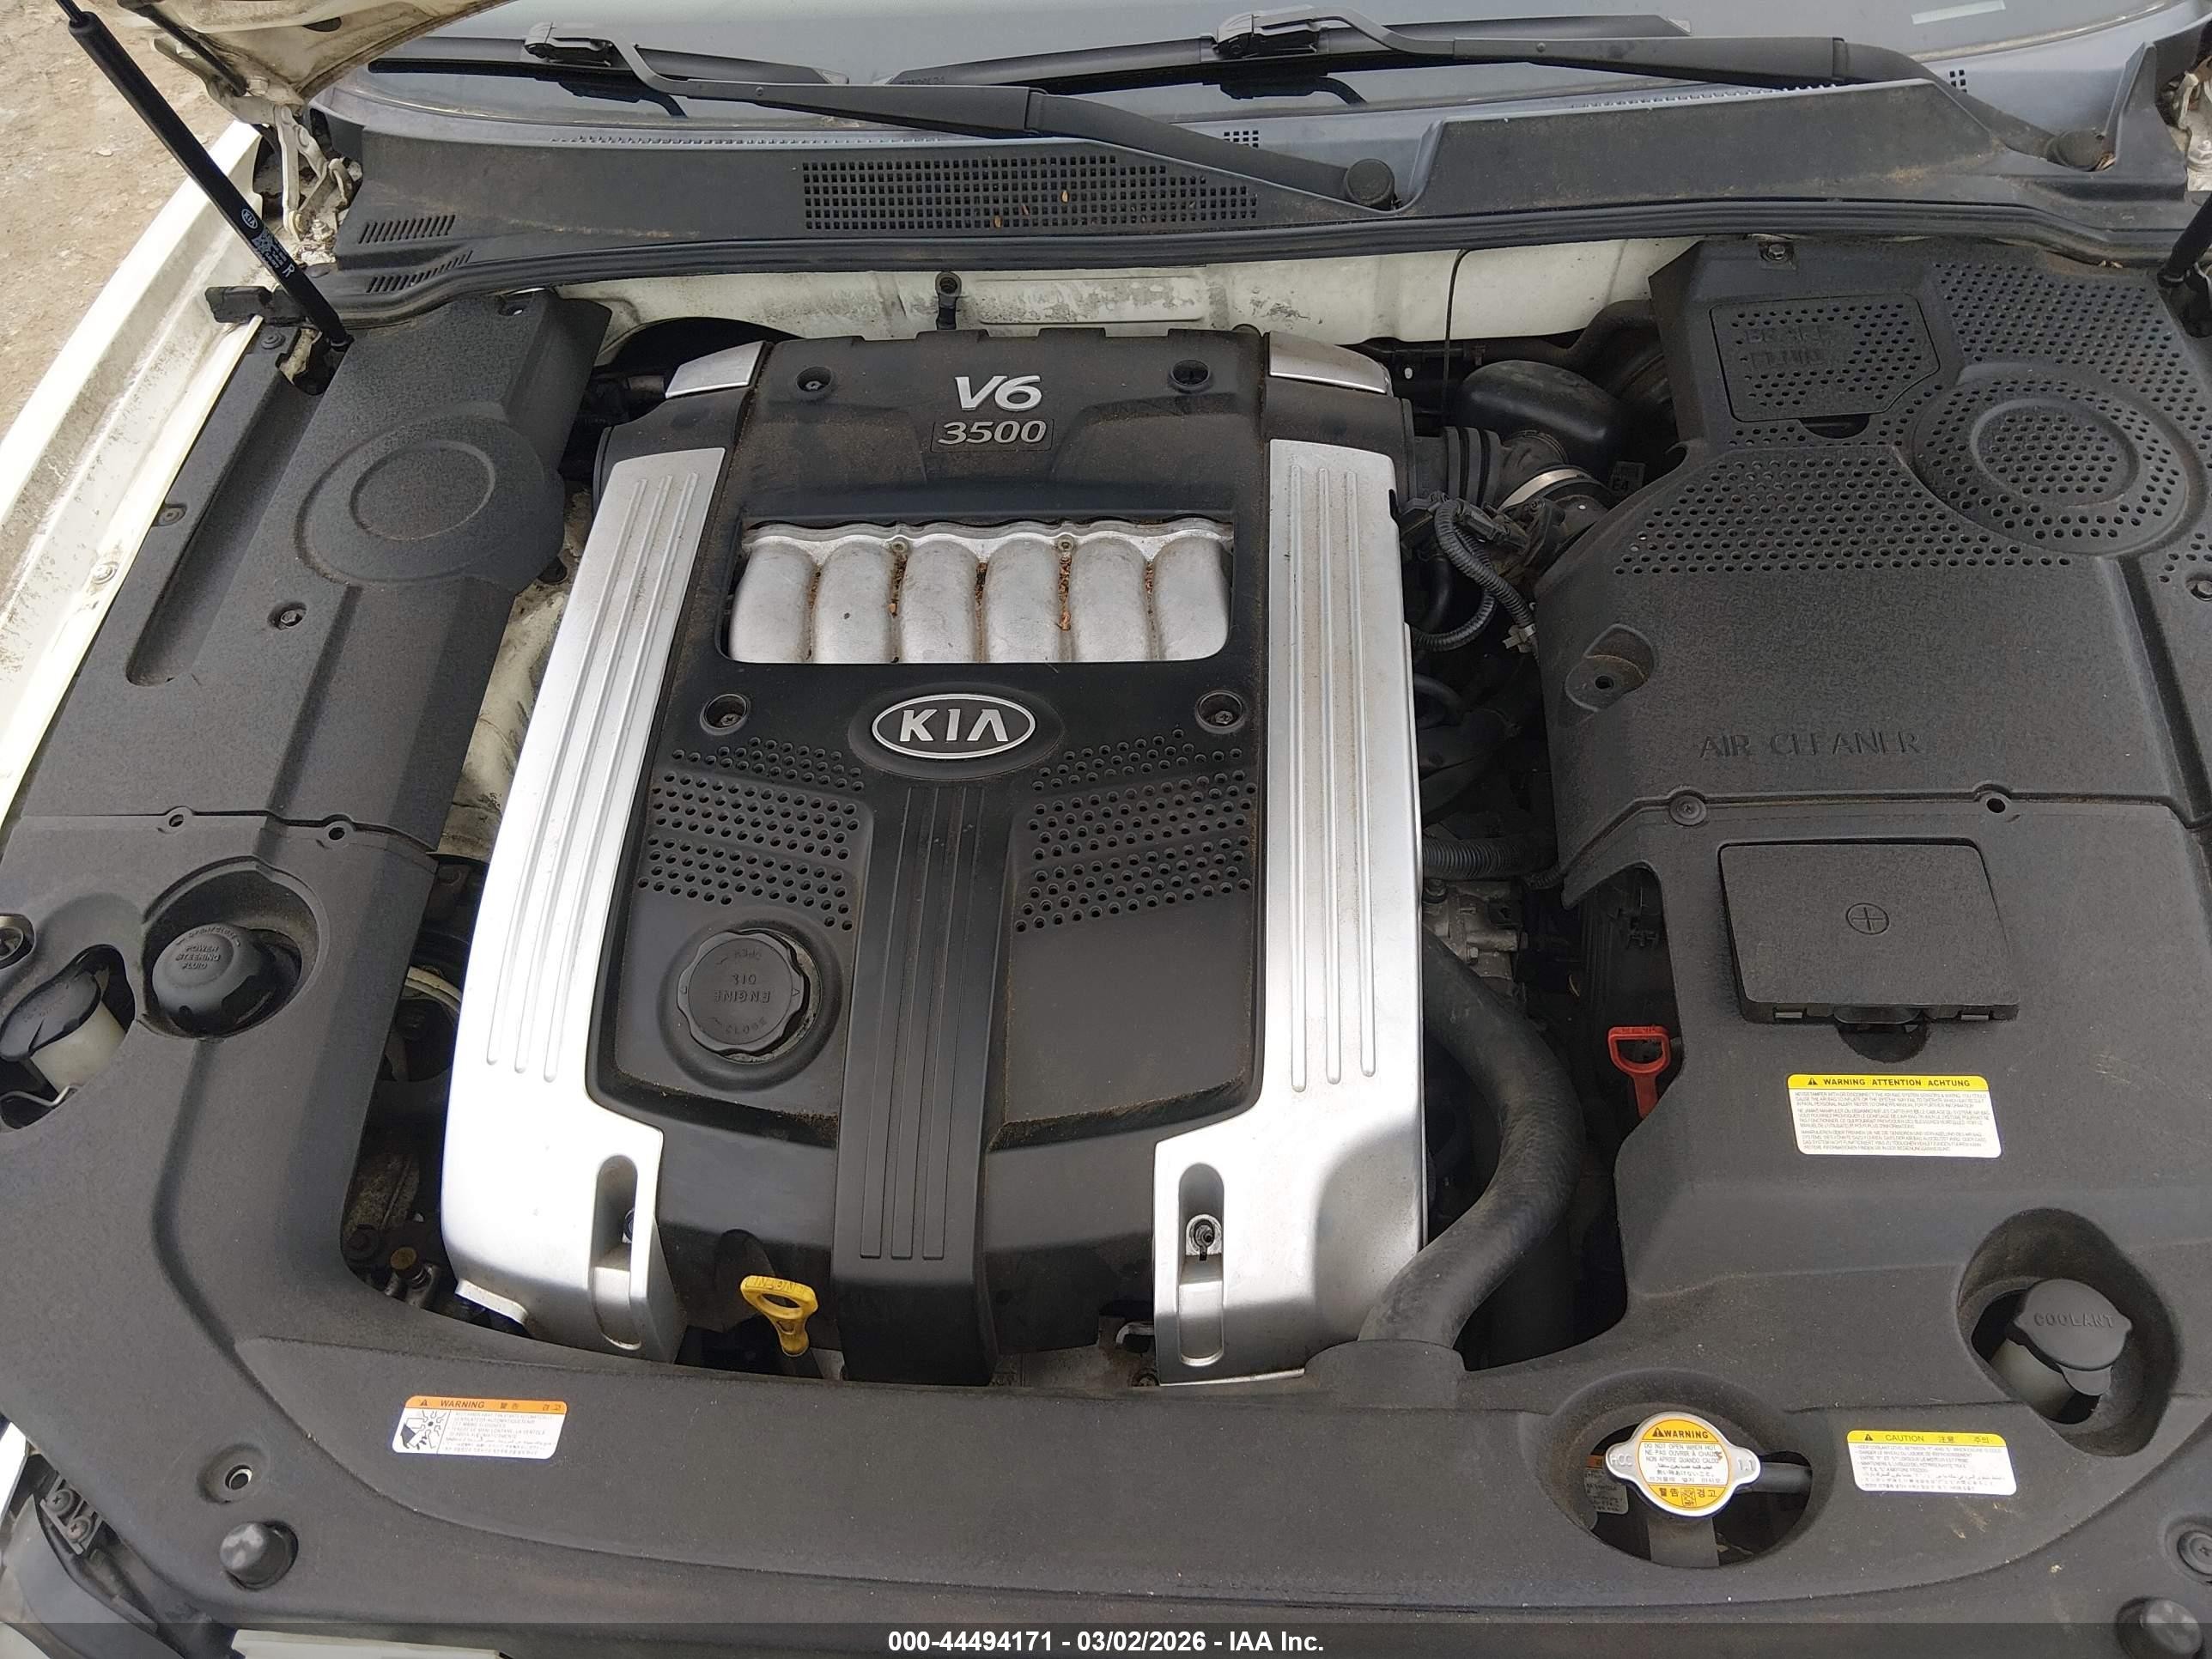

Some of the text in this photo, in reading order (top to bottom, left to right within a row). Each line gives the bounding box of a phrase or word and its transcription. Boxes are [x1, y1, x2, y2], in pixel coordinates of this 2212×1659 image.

[282, 264, 295, 278] R
[955, 375, 1042, 411] V6
[938, 420, 1047, 445] 3500
[899, 708, 1009, 741] KIA
[1699, 734, 1750, 757] AIR
[714, 989, 771, 1004] ENGINE
[2033, 1312, 2113, 1328] COOLANT
[440, 1400, 485, 1408] WARNING
[1663, 1430, 1709, 1439] WARNING
